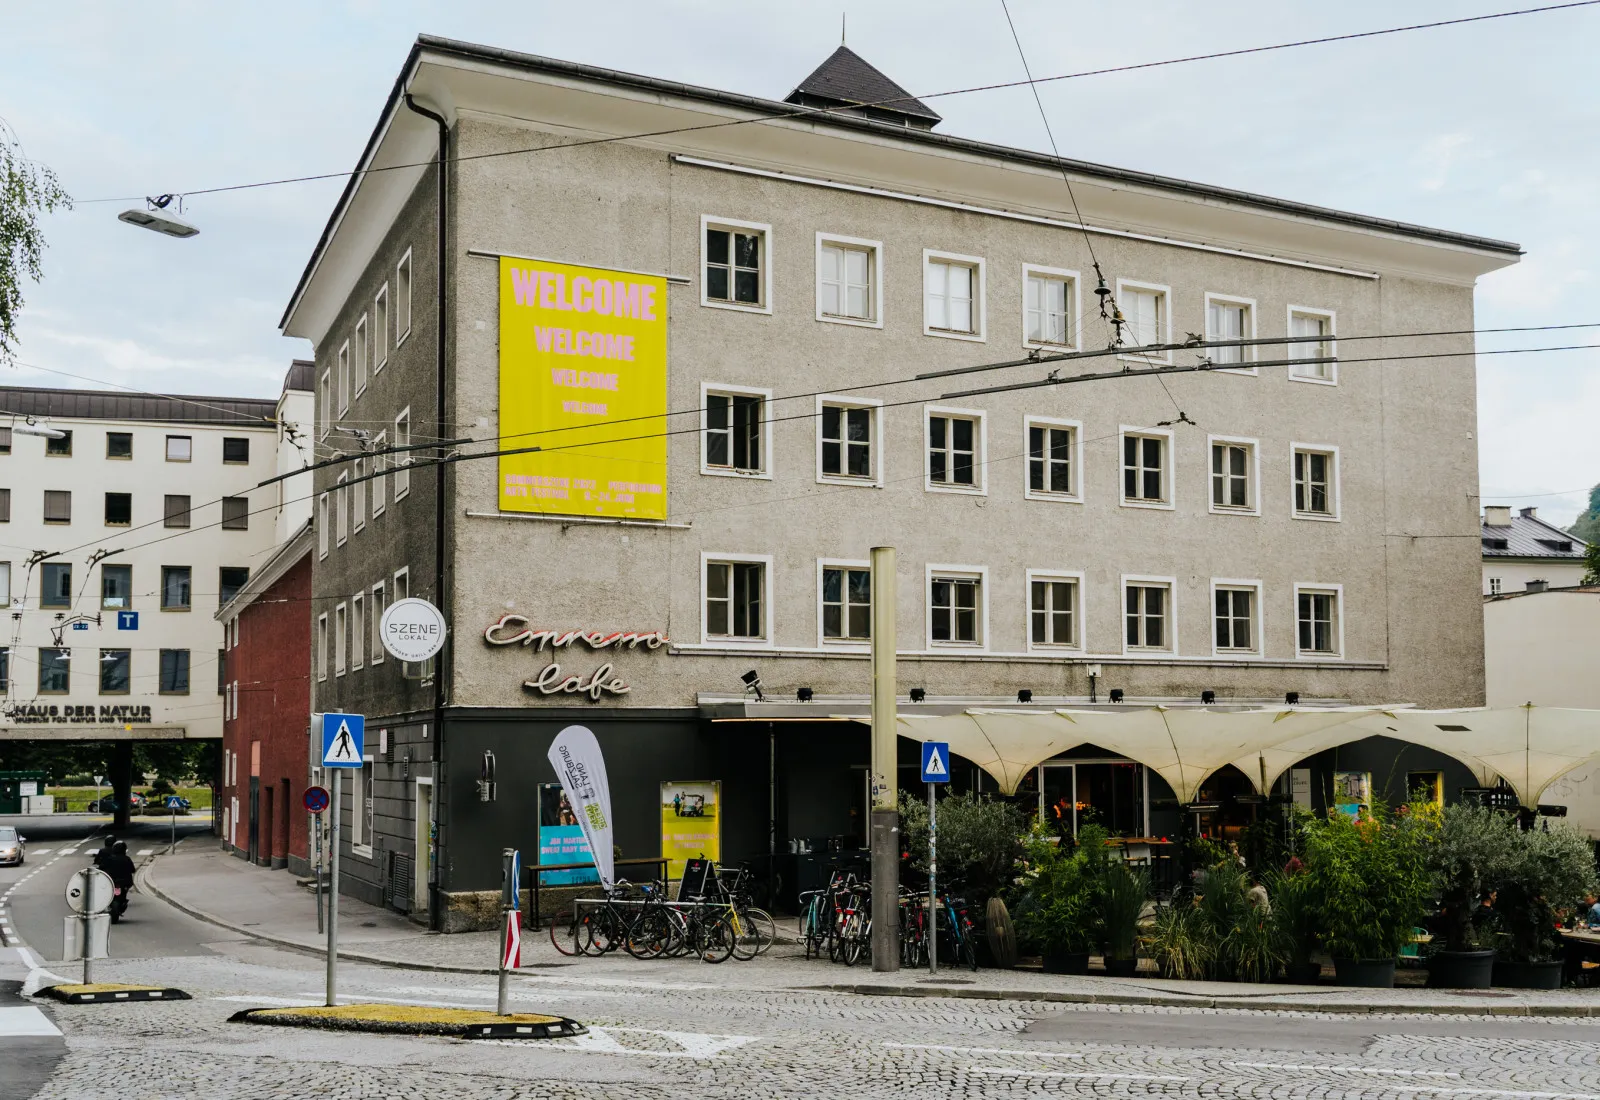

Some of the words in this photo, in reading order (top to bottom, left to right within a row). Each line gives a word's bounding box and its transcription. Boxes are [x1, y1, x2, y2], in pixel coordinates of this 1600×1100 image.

[510, 267, 657, 321] WELCOME
[533, 325, 635, 361] WELCOME
[551, 367, 620, 391] WELCOME
[562, 400, 608, 416] WELCOME
[122, 614, 135, 628] T
[389, 623, 438, 634] SZENE
[15, 705, 59, 716] HAUS
[64, 705, 96, 716] DER
[100, 705, 152, 716] NATUR
